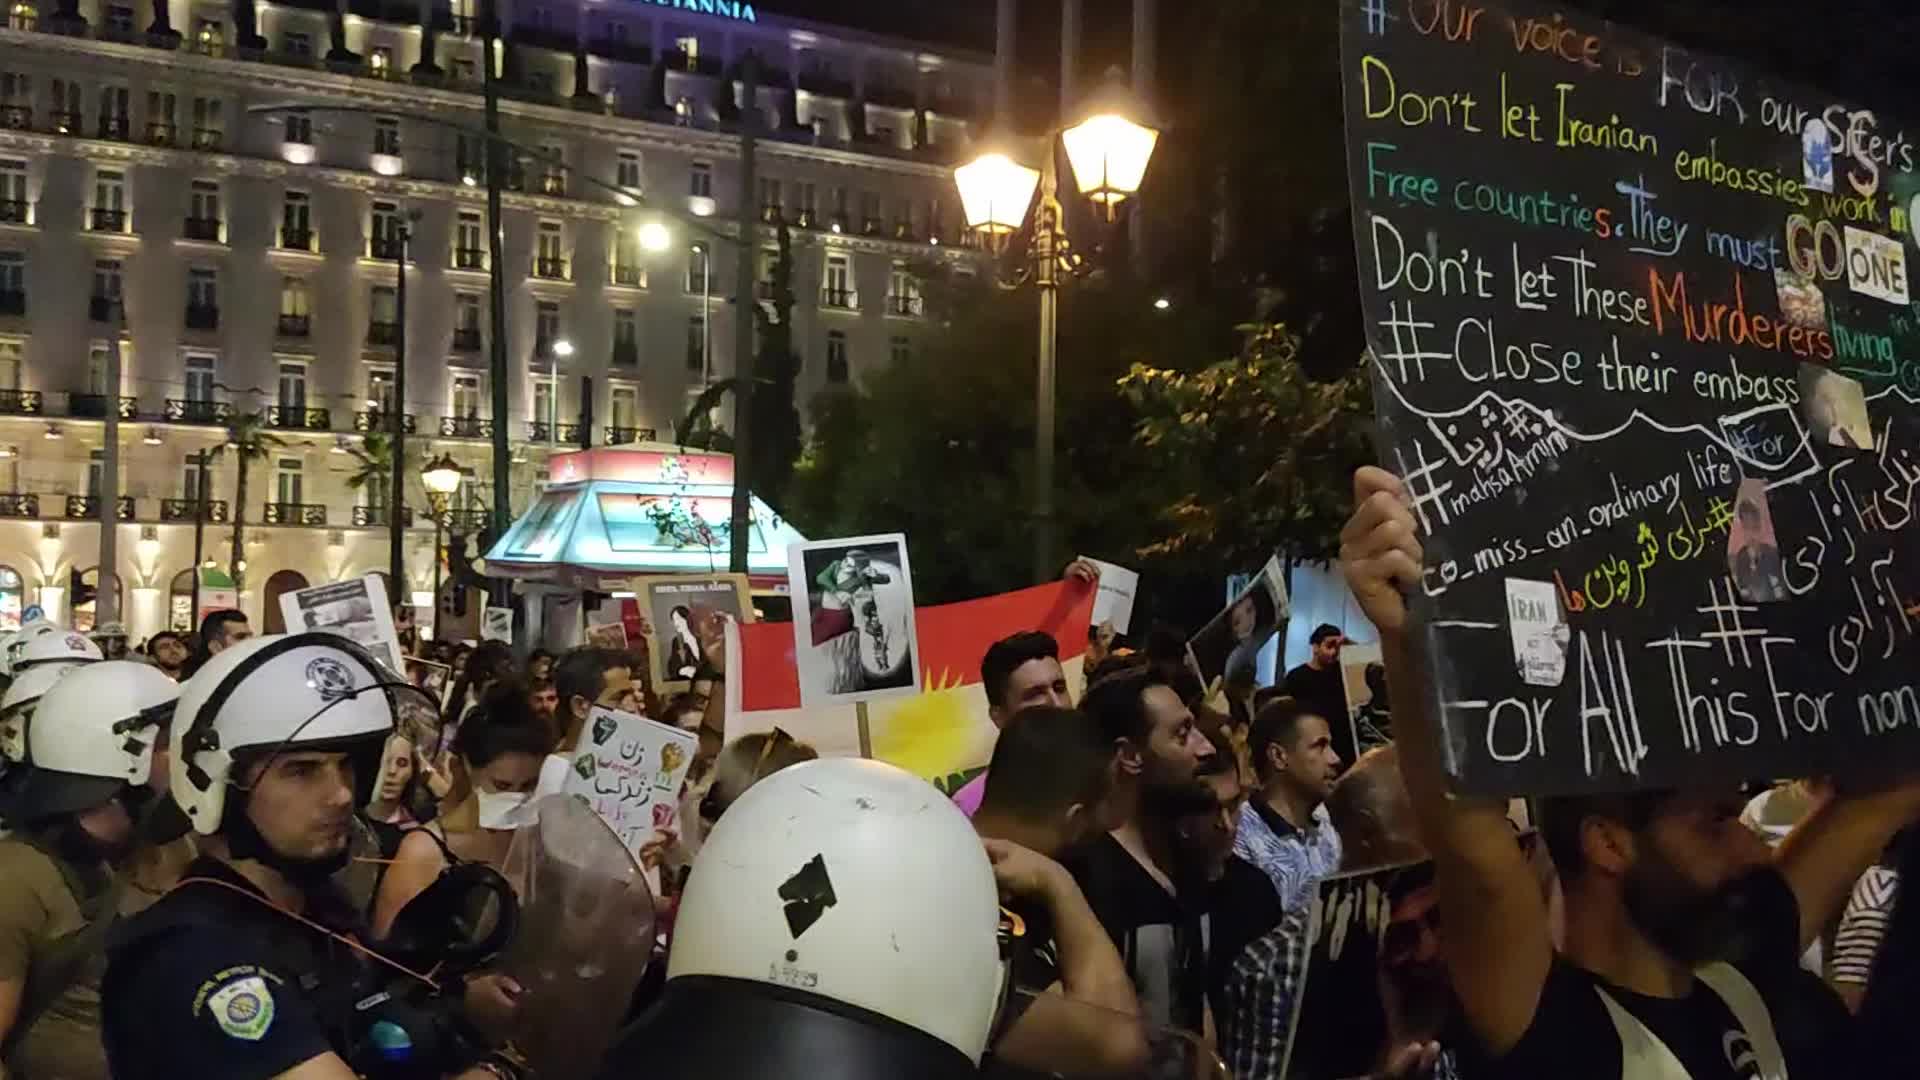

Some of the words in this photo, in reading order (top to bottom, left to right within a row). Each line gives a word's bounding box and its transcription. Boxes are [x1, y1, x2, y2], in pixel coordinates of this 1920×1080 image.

[1361, 55, 1482, 132] Don't
[1500, 71, 1543, 142] let
[1555, 83, 1658, 156] Iranian
[1675, 136, 1809, 206] embassies
[1511, 13, 1602, 72] voice
[1760, 97, 1809, 138] our
[1367, 142, 1440, 206] Free
[1706, 228, 1782, 272] must
[1367, 214, 1494, 298] Don't
[1513, 241, 1558, 311] Let
[1550, 248, 1650, 325] These
[1649, 264, 1834, 360] Murderers
[1850, 247, 1905, 295] ONE
[1596, 334, 1678, 395] their
[1688, 445, 1736, 490] life
[1428, 620, 1552, 778] For
[1645, 626, 1760, 754] This
[1760, 636, 1835, 741] For
